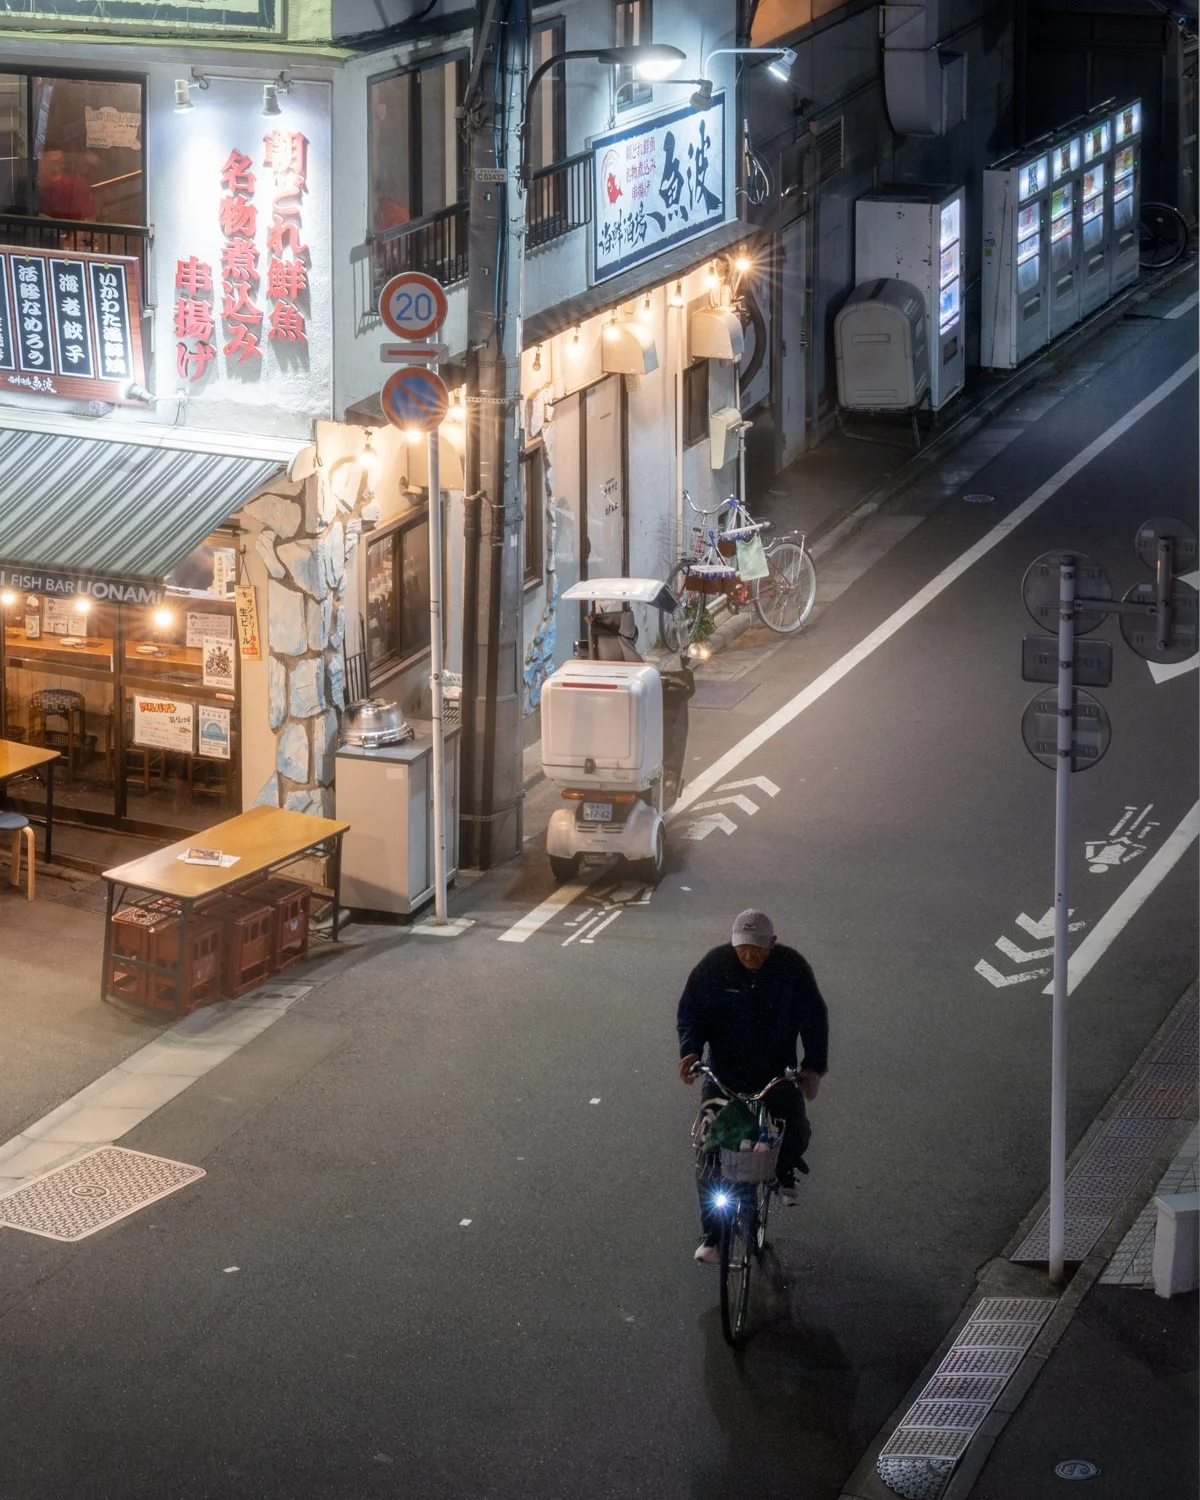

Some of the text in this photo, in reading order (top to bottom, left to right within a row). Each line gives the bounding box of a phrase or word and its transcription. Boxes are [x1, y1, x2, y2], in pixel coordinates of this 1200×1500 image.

[626, 157, 657, 184] 名物煮込み
[631, 180, 651, 200] 串揚げ
[645, 118, 723, 233] 魚波
[598, 201, 648, 257] 海鮮酒場
[218, 148, 263, 364] 名物煮込み
[58, 273, 86, 364] 海老餃子
[173, 254, 217, 383] 串揚げ
[395, 292, 432, 322] 20
[11, 573, 43, 592] FISH
[45, 577, 75, 595] BAR
[76, 580, 164, 606] UONAMI
[239, 606, 251, 645] 生ビール
